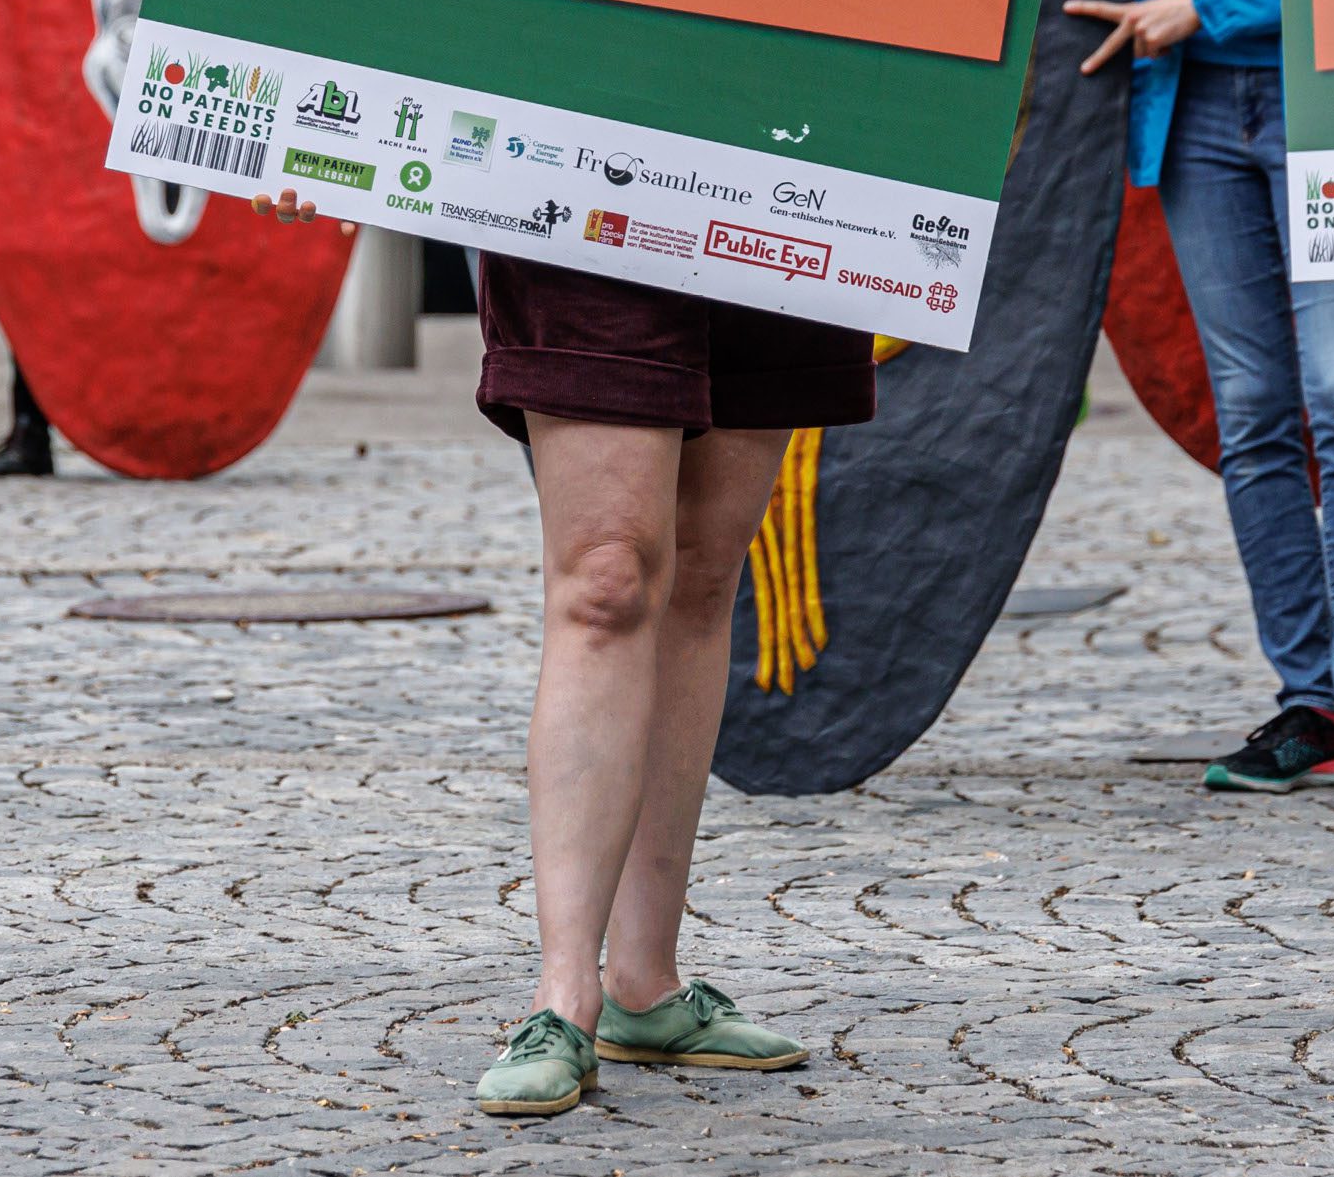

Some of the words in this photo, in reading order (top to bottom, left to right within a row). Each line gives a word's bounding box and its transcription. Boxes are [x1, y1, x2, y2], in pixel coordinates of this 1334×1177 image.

[141, 82, 173, 101] NO
[182, 90, 276, 123] PATENTS
[138, 99, 173, 119] ON
[188, 108, 272, 140] SEEDS!
[378, 139, 403, 148] ARCHE
[407, 145, 427, 154] NOAH
[452, 137, 472, 146] BUND
[533, 141, 565, 153] Corporate
[451, 144, 484, 156] Naturschutz
[455, 152, 473, 161] Bayern
[536, 149, 558, 159] Europe
[292, 163, 313, 174] AUF
[294, 152, 320, 166] KEIN
[323, 159, 366, 175] PATENT
[526, 155, 565, 169] Observatory
[773, 181, 827, 211] GeN
[386, 194, 434, 216] OXFAM
[1307, 202, 1334, 215] NO
[441, 202, 518, 228] TRANSGÉNICOS
[770, 205, 835, 227] Gen-ethisches
[835, 219, 879, 236] Netzwerk
[879, 228, 897, 240] e.V.
[602, 223, 614, 231] pro
[631, 219, 675, 234] Schweizerische
[675, 229, 698, 240] Stiftung
[912, 214, 970, 241] Gegen
[599, 237, 613, 245] rara
[600, 230, 624, 240] specie
[649, 232, 697, 246] kulturhistorische
[638, 244, 663, 254] Pflanzen
[664, 248, 675, 256] und
[676, 252, 695, 260] Tieren
[640, 237, 672, 248] genetische
[673, 243, 693, 253] Vielfalt
[712, 229, 776, 261] Public
[780, 244, 821, 270] Eye
[837, 269, 923, 299] SWISSAID
